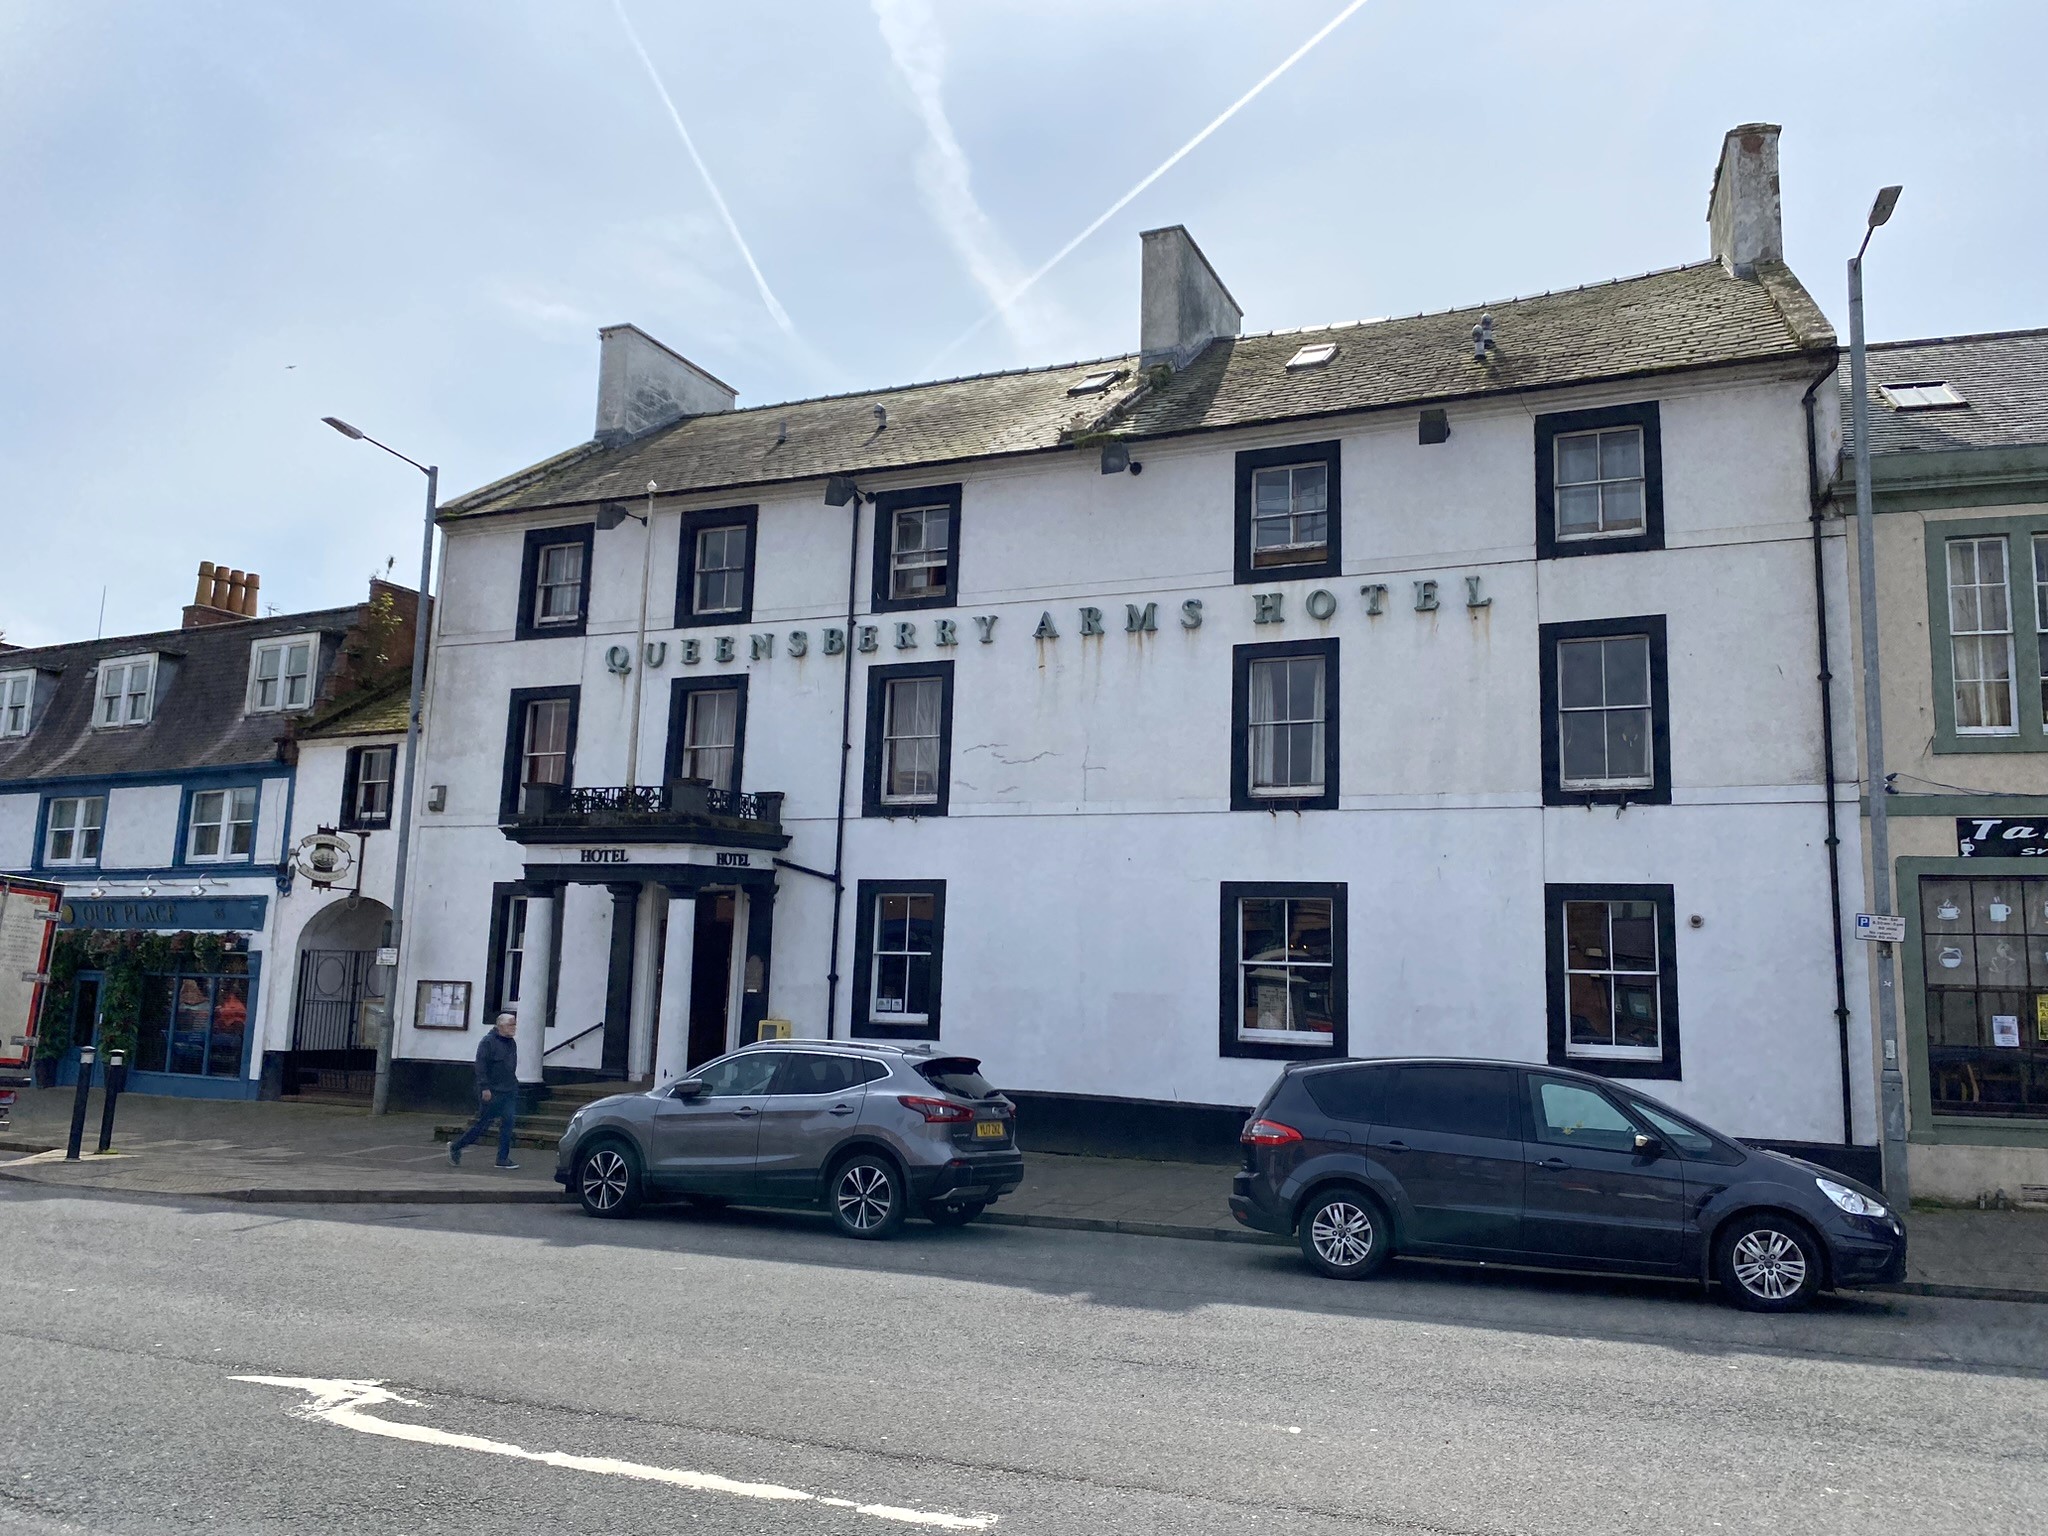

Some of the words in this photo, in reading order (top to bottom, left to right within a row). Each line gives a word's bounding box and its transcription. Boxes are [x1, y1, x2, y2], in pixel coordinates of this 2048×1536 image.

[605, 615, 998, 675] QUEENSBERRY
[1033, 598, 1203, 639] ARMS
[1253, 576, 1493, 625] HOTEL
[580, 849, 629, 863] HOTEL
[716, 852, 751, 867] HOTEL
[83, 904, 117, 923] OUR
[123, 904, 178, 923] PLACE
[1860, 917, 1868, 927] P
